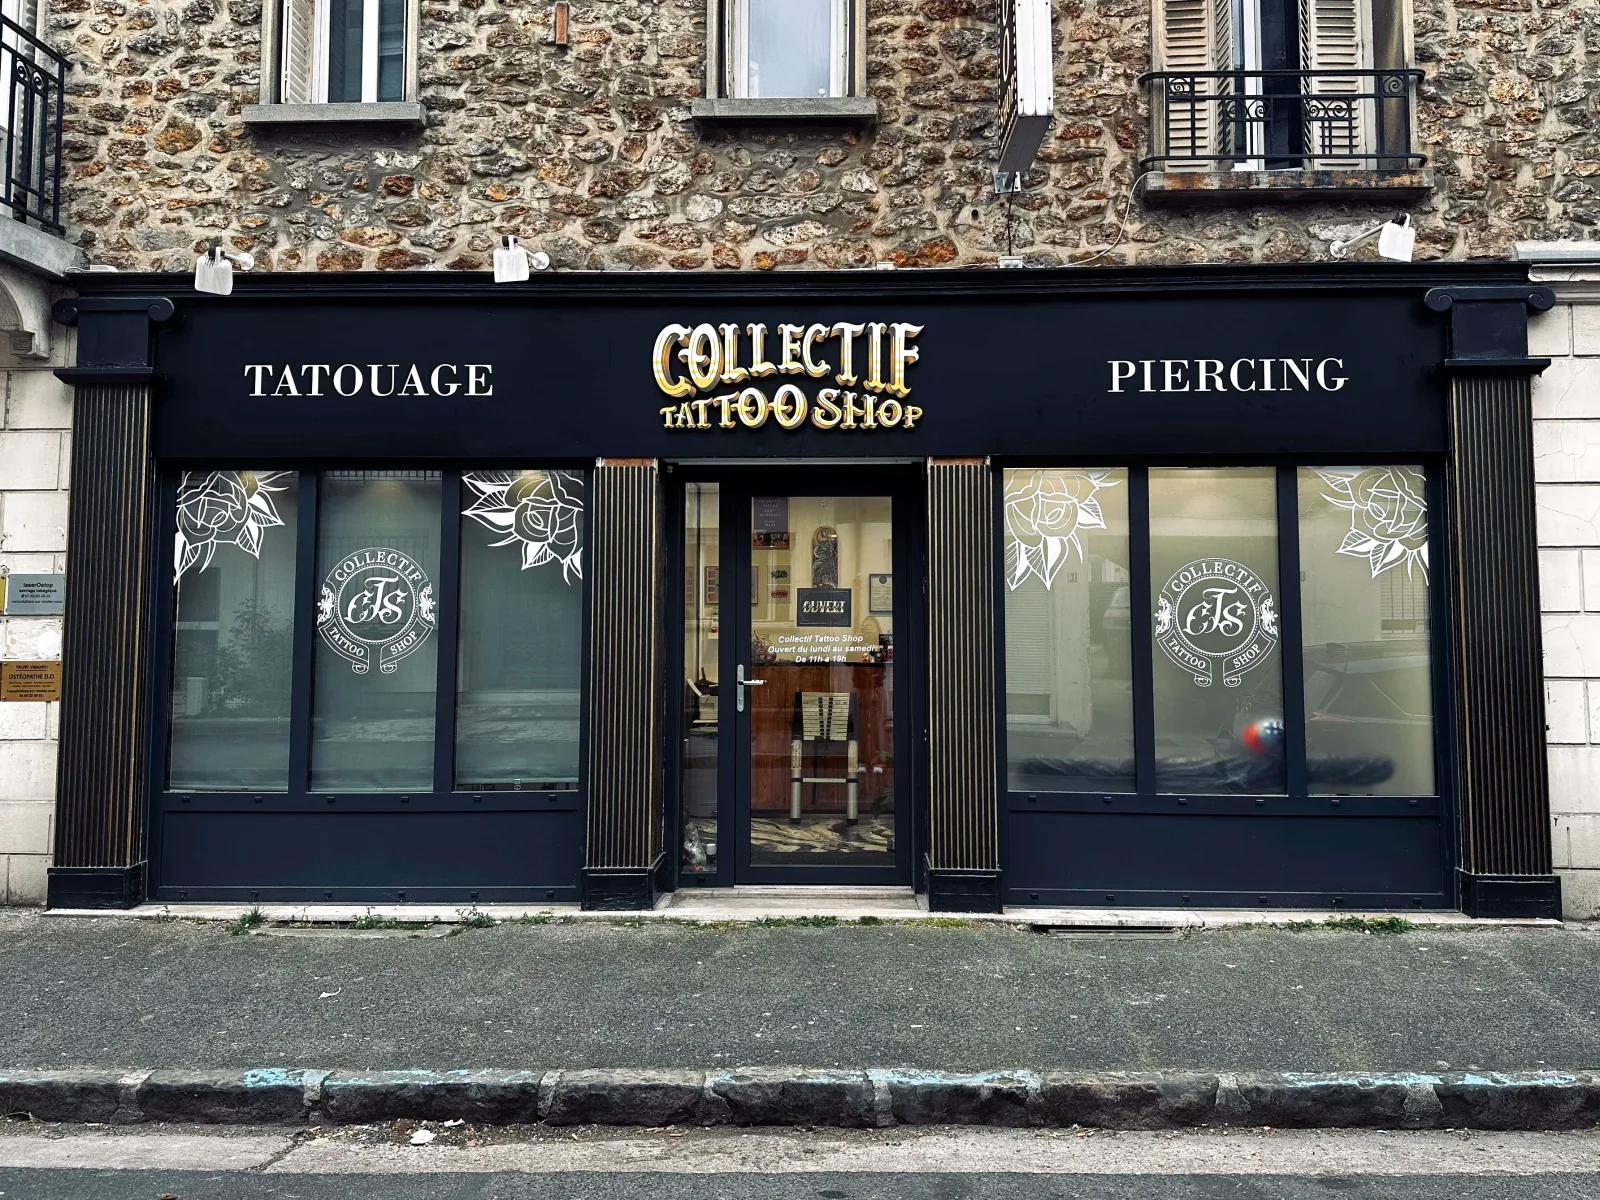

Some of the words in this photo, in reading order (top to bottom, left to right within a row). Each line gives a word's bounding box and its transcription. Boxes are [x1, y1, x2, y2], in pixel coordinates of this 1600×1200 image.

[652, 322, 925, 398] COLLECTIF
[1107, 358, 1349, 393] PIERCING
[244, 363, 493, 397] TATOUAGE
[659, 384, 808, 429] TATTOO
[811, 387, 923, 430] SHOP
[335, 551, 423, 582] COLLECTIF
[1171, 561, 1262, 592] COLLECTIF
[802, 600, 846, 613] OUVERT
[329, 627, 364, 657] TATTOO
[390, 631, 418, 655] SHOP
[768, 645, 796, 653] Ouvert
[797, 645, 808, 653] du
[845, 644, 875, 652] samedi
[778, 635, 812, 643] Collectif
[814, 635, 840, 643] Tattoo
[842, 635, 864, 643] Shop
[1168, 638, 1206, 669] TATTOO
[1232, 643, 1262, 669] SHOP
[795, 655, 807, 663] De
[809, 655, 823, 663] 11h
